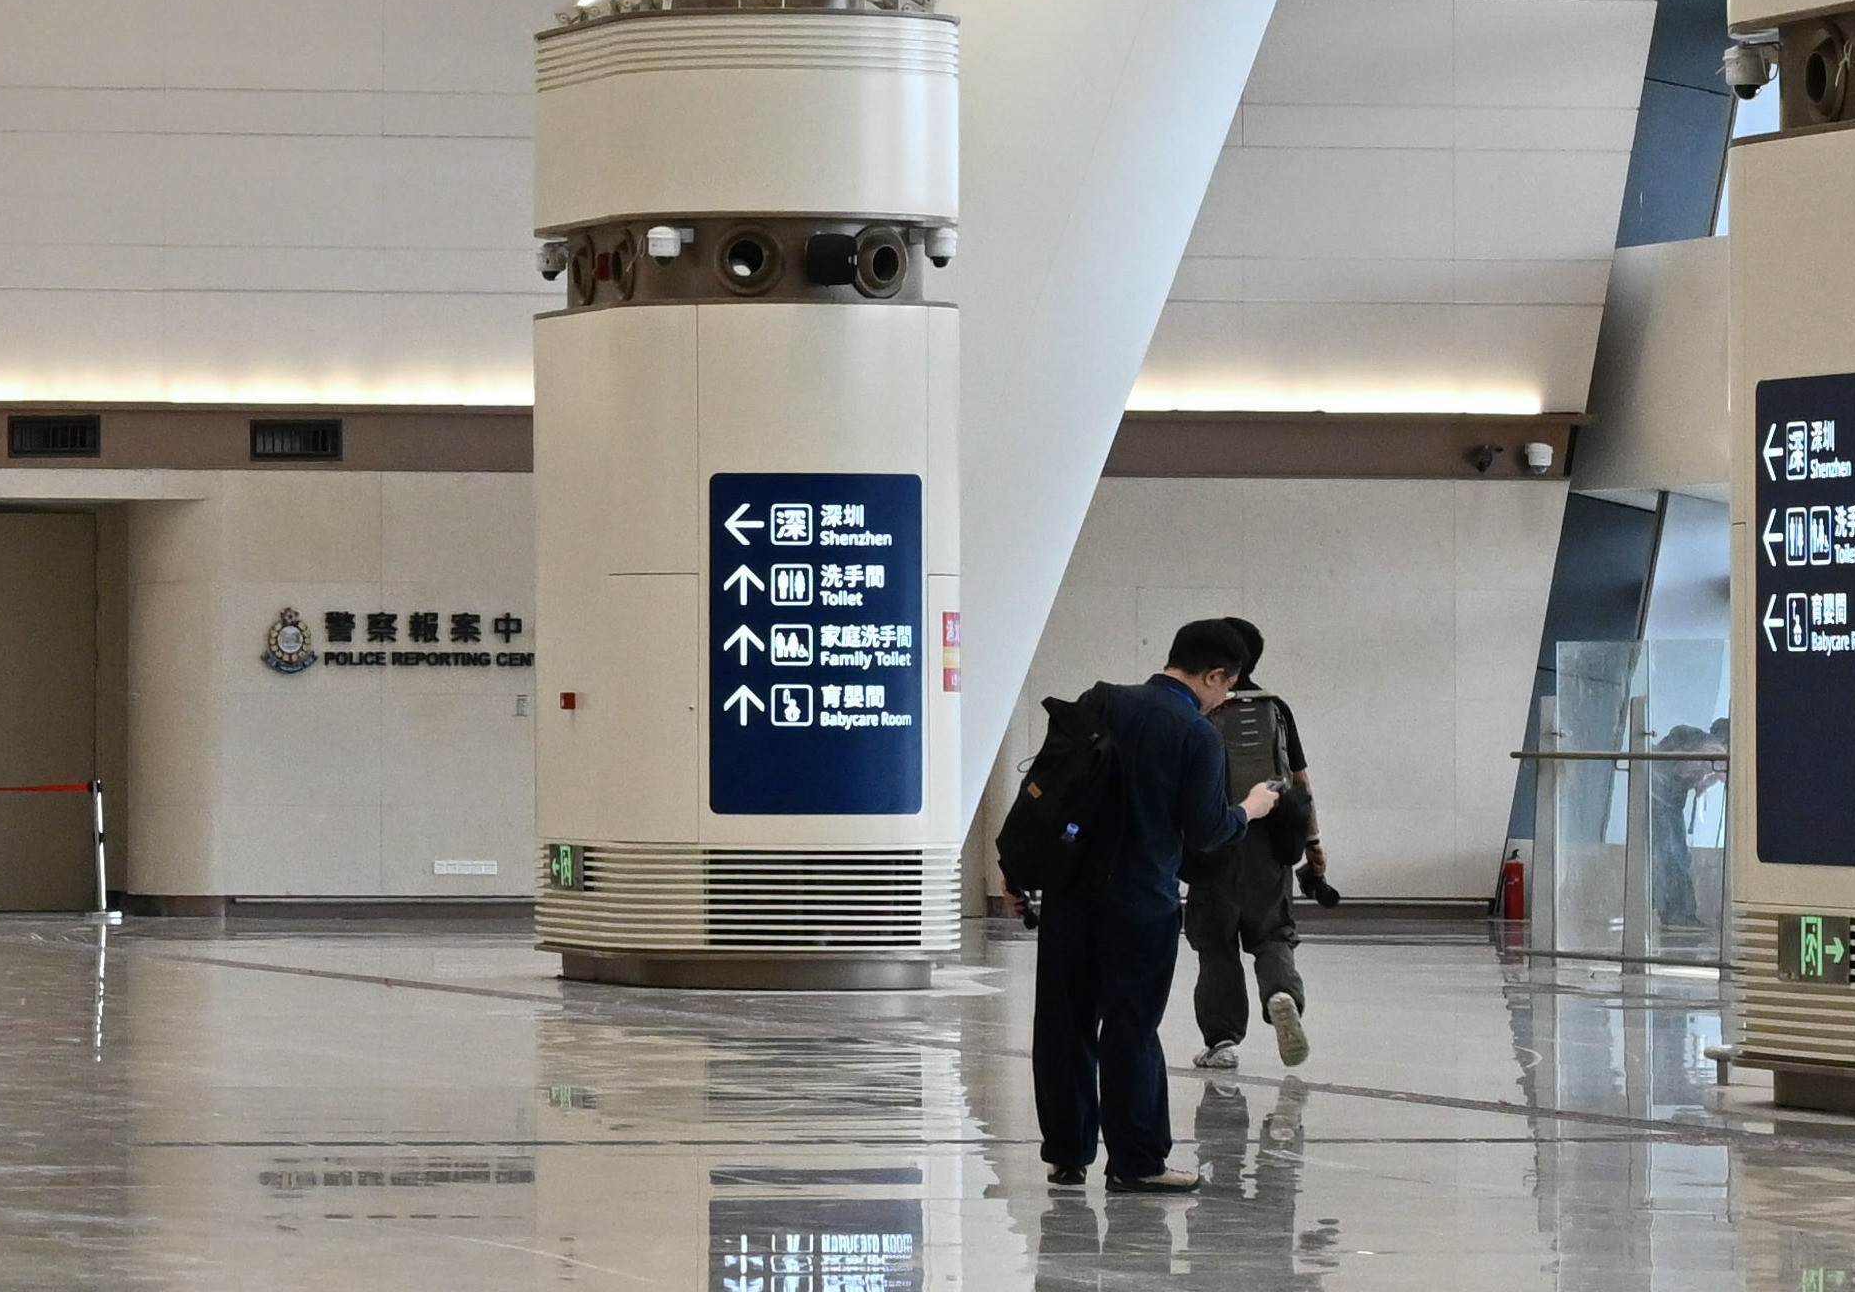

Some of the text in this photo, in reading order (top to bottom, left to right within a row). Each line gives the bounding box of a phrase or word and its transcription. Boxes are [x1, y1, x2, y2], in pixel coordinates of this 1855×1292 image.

[1810, 419, 1836, 452] 深圳
[1809, 457, 1852, 479] Shenzhen
[819, 504, 865, 528] 深圳
[819, 529, 893, 547] Shenzhen
[820, 564, 885, 589] 洗手間
[819, 590, 864, 607] Toilet
[1810, 593, 1848, 626] 育嬰間
[324, 611, 523, 644] 警察報案中
[820, 624, 913, 649] 家庭洗手間
[1810, 631, 1850, 657] Babycare
[323, 651, 387, 667] POLICE
[391, 651, 492, 667] REPORTING
[496, 651, 535, 667] CEN
[819, 650, 912, 671] Family Toilet
[820, 684, 885, 709] 育嬰間
[819, 710, 913, 731] Babycare Room
